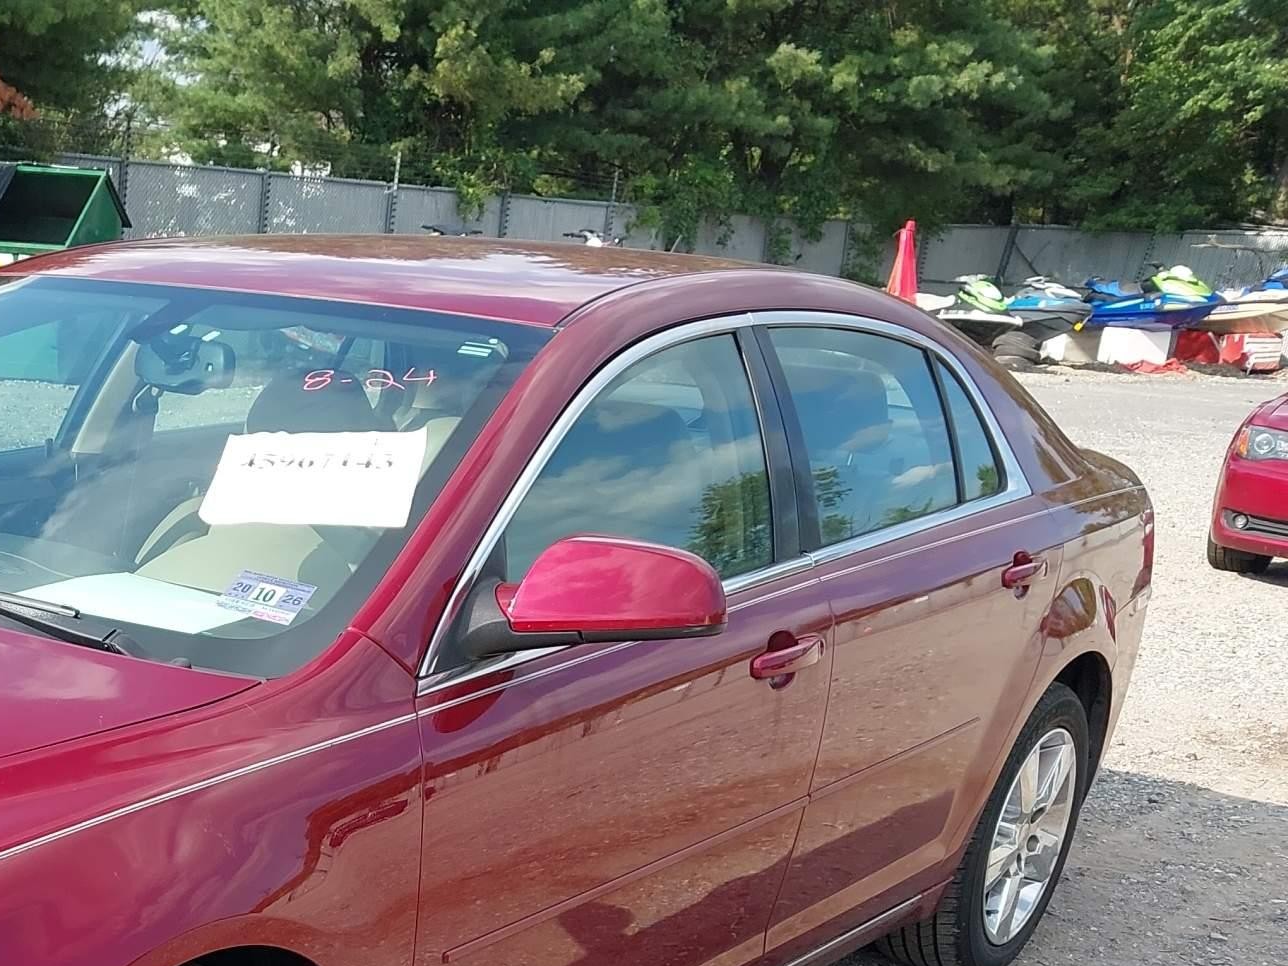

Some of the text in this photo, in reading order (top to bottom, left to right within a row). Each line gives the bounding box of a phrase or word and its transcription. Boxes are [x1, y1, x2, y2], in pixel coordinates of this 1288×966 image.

[232, 581, 253, 594] 20
[253, 586, 277, 603] 10
[281, 594, 304, 607] 26
